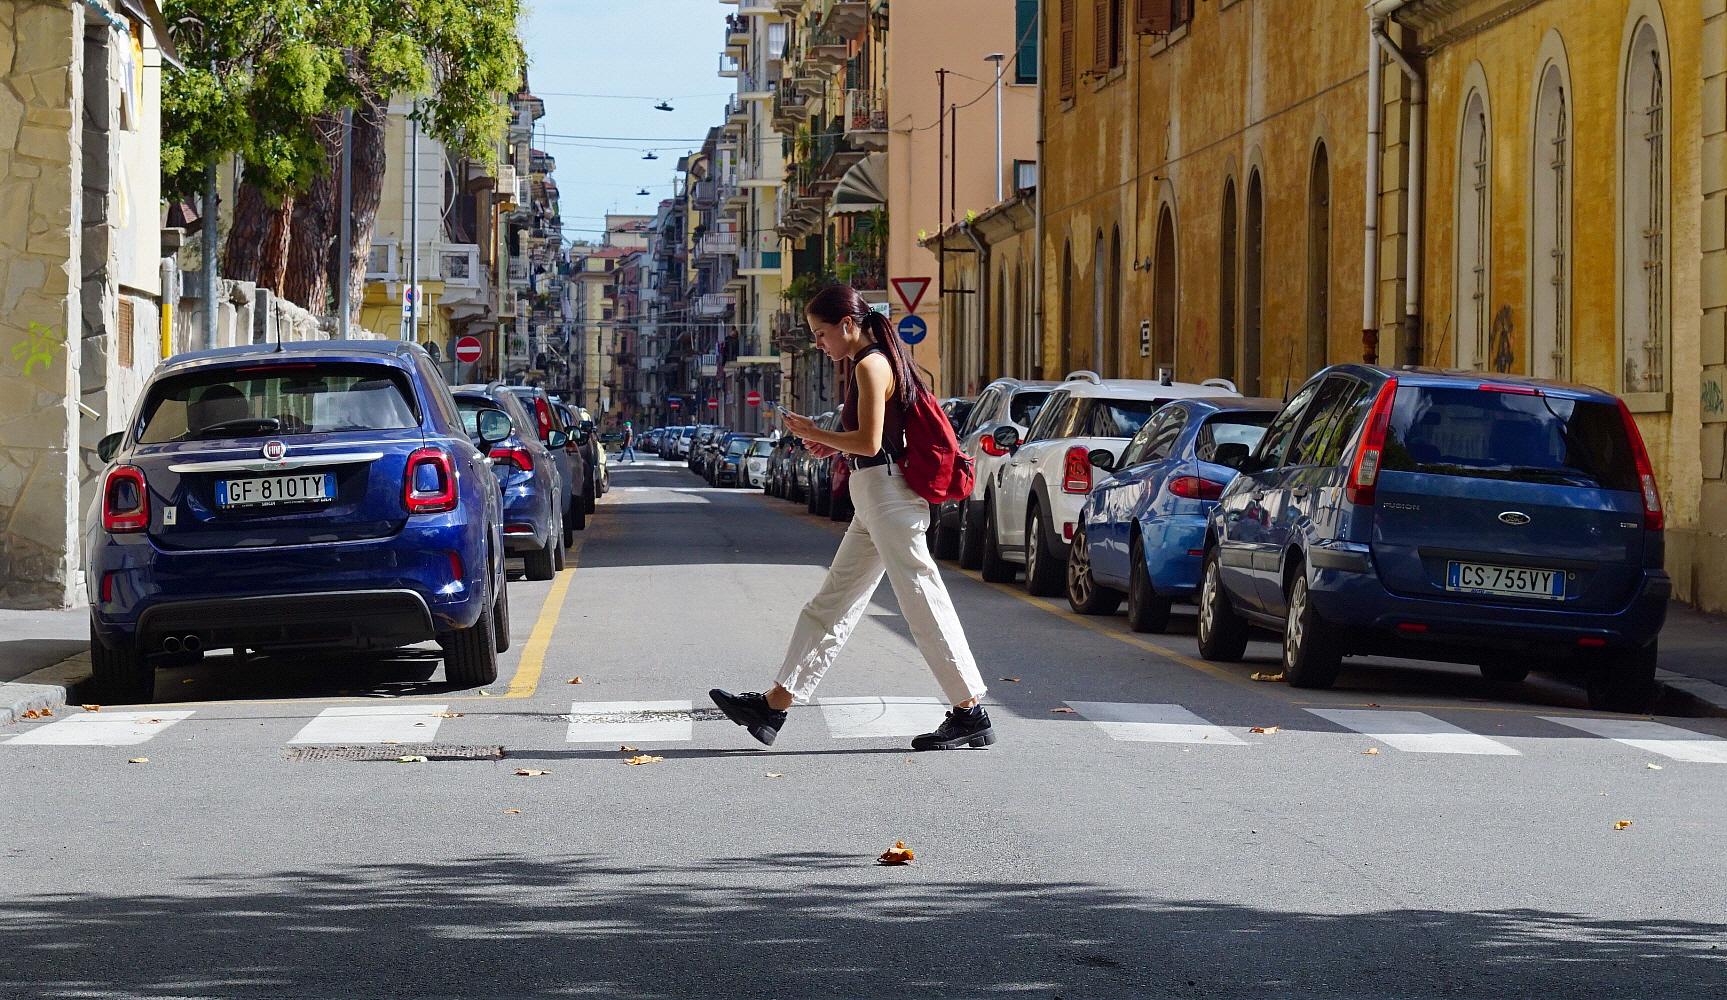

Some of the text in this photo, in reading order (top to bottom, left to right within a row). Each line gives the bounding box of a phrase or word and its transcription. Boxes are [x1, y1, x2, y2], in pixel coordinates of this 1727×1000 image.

[230, 482, 252, 502] GF
[262, 476, 322, 499] 810TY
[1462, 565, 1485, 586] CS
[1492, 568, 1551, 592] 755VY
